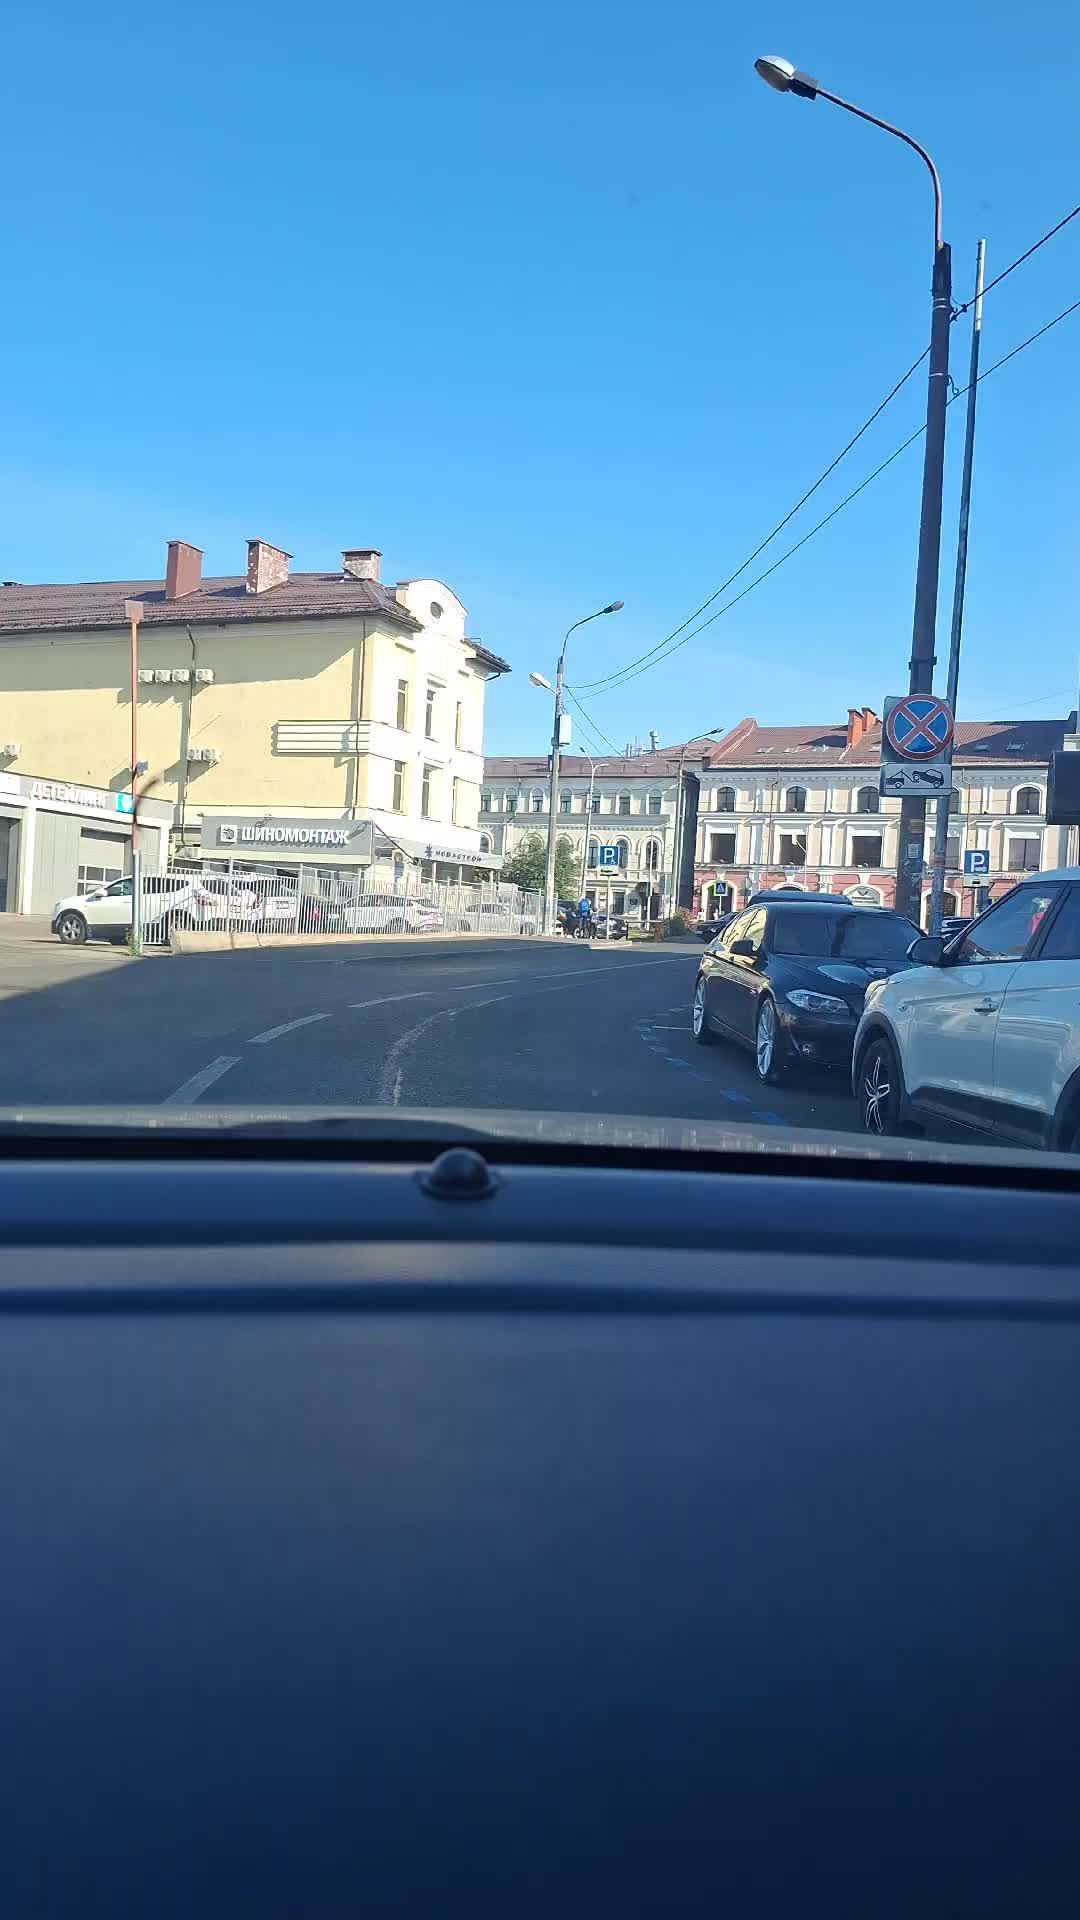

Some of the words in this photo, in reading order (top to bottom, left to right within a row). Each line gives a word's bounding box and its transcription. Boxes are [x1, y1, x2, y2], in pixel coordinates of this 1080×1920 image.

[241, 826, 350, 845] ШИНОМОНТАЖ
[604, 847, 615, 864] P
[970, 852, 985, 873] P
